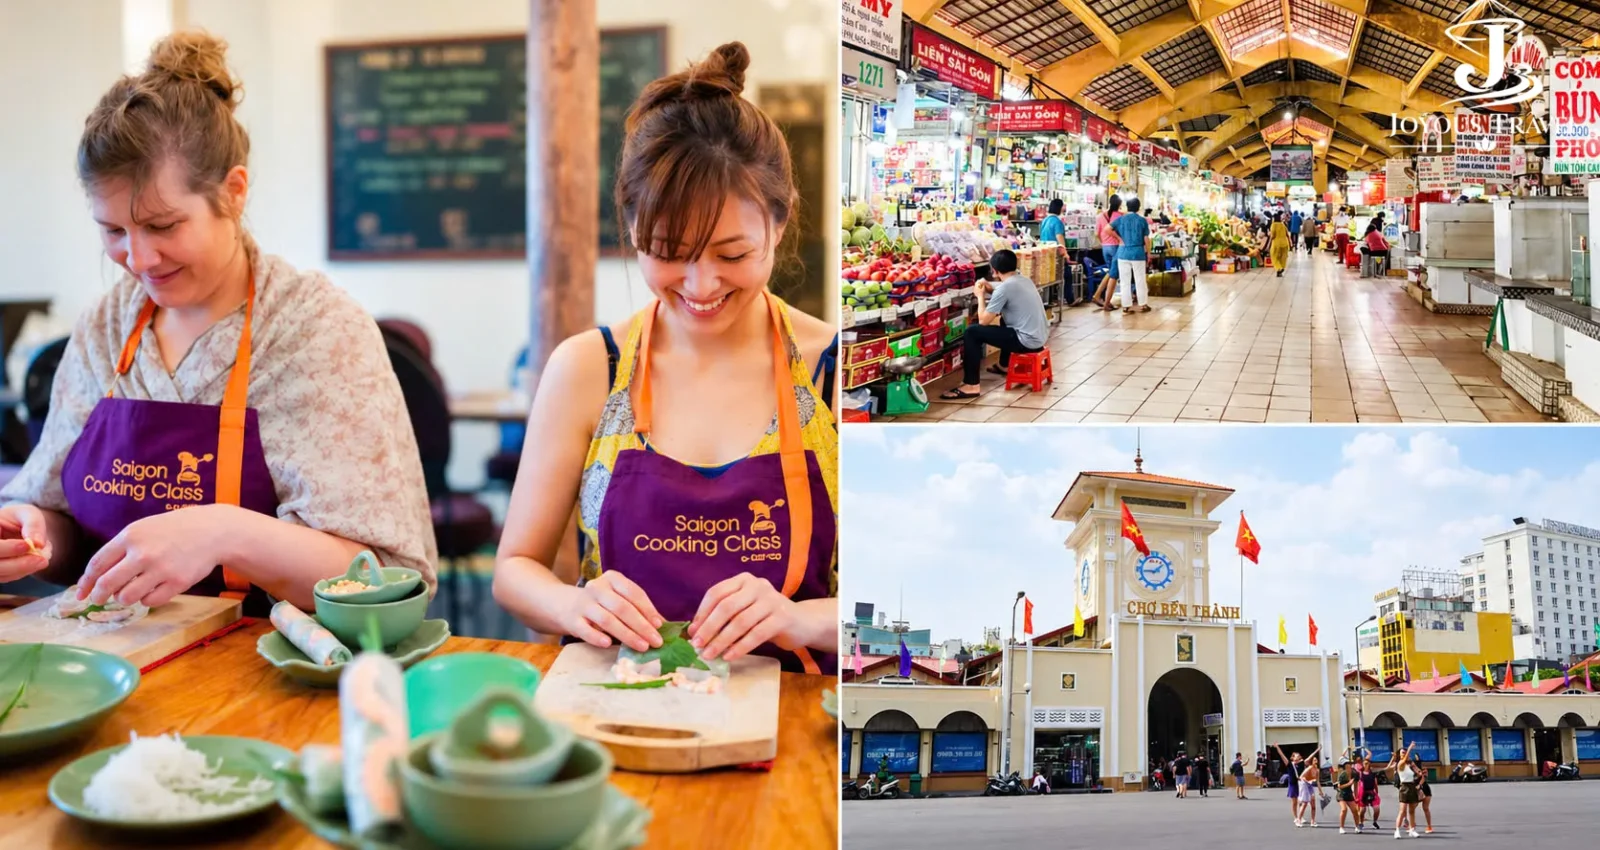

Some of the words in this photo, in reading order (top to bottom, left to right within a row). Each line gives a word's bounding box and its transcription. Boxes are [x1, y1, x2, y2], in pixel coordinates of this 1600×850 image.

[859, 60, 884, 88] 1271
[1555, 80, 1600, 124] BÚN
[112, 458, 168, 481] Saigon
[83, 474, 146, 501] Cooking
[151, 482, 204, 501] Class
[675, 515, 740, 536] Saigon
[634, 534, 718, 557] Cooking
[724, 535, 782, 552] Class
[1127, 600, 1157, 618] CHỢ
[1161, 600, 1187, 617] BẾN
[1192, 603, 1240, 619] THÀNH
